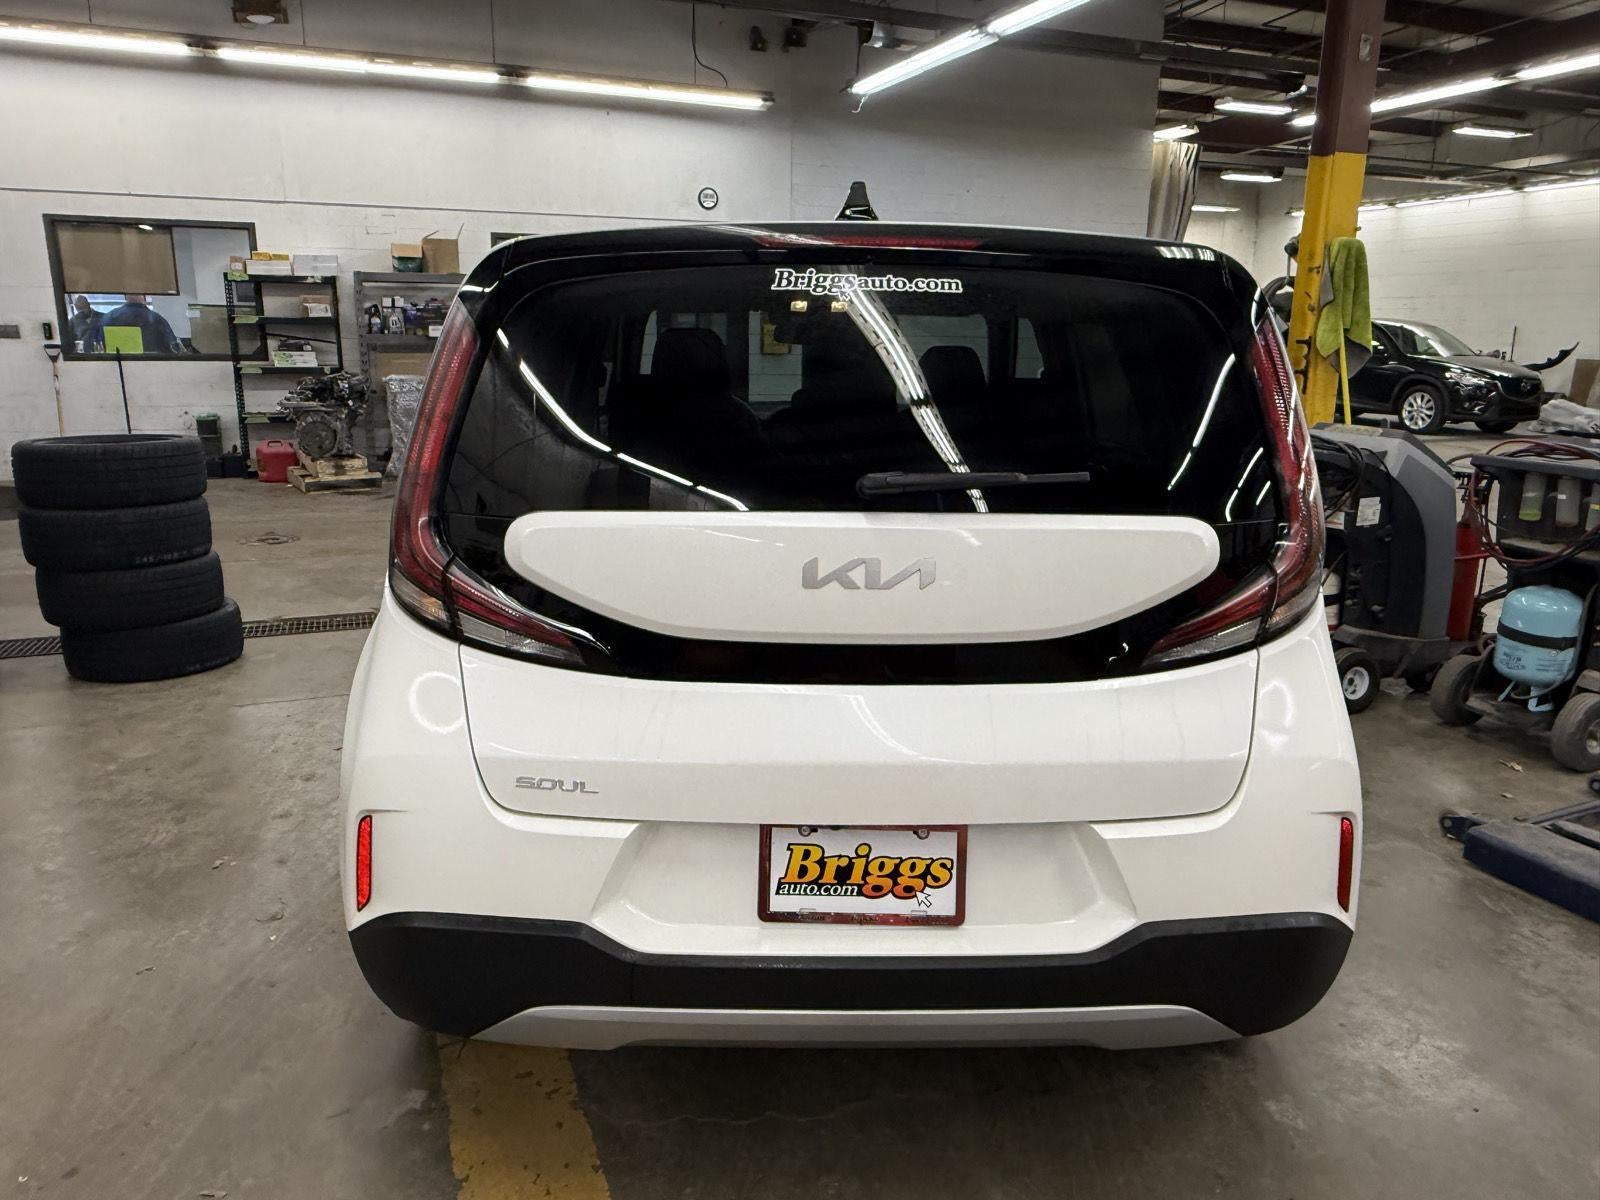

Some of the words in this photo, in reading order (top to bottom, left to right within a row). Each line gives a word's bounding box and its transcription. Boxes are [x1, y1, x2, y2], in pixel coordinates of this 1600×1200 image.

[771, 269, 962, 294] Briggsauto.com
[801, 556, 937, 590] KIA
[515, 775, 599, 794] SOUL
[780, 844, 953, 899] Briggs
[779, 883, 858, 896] auto.com
